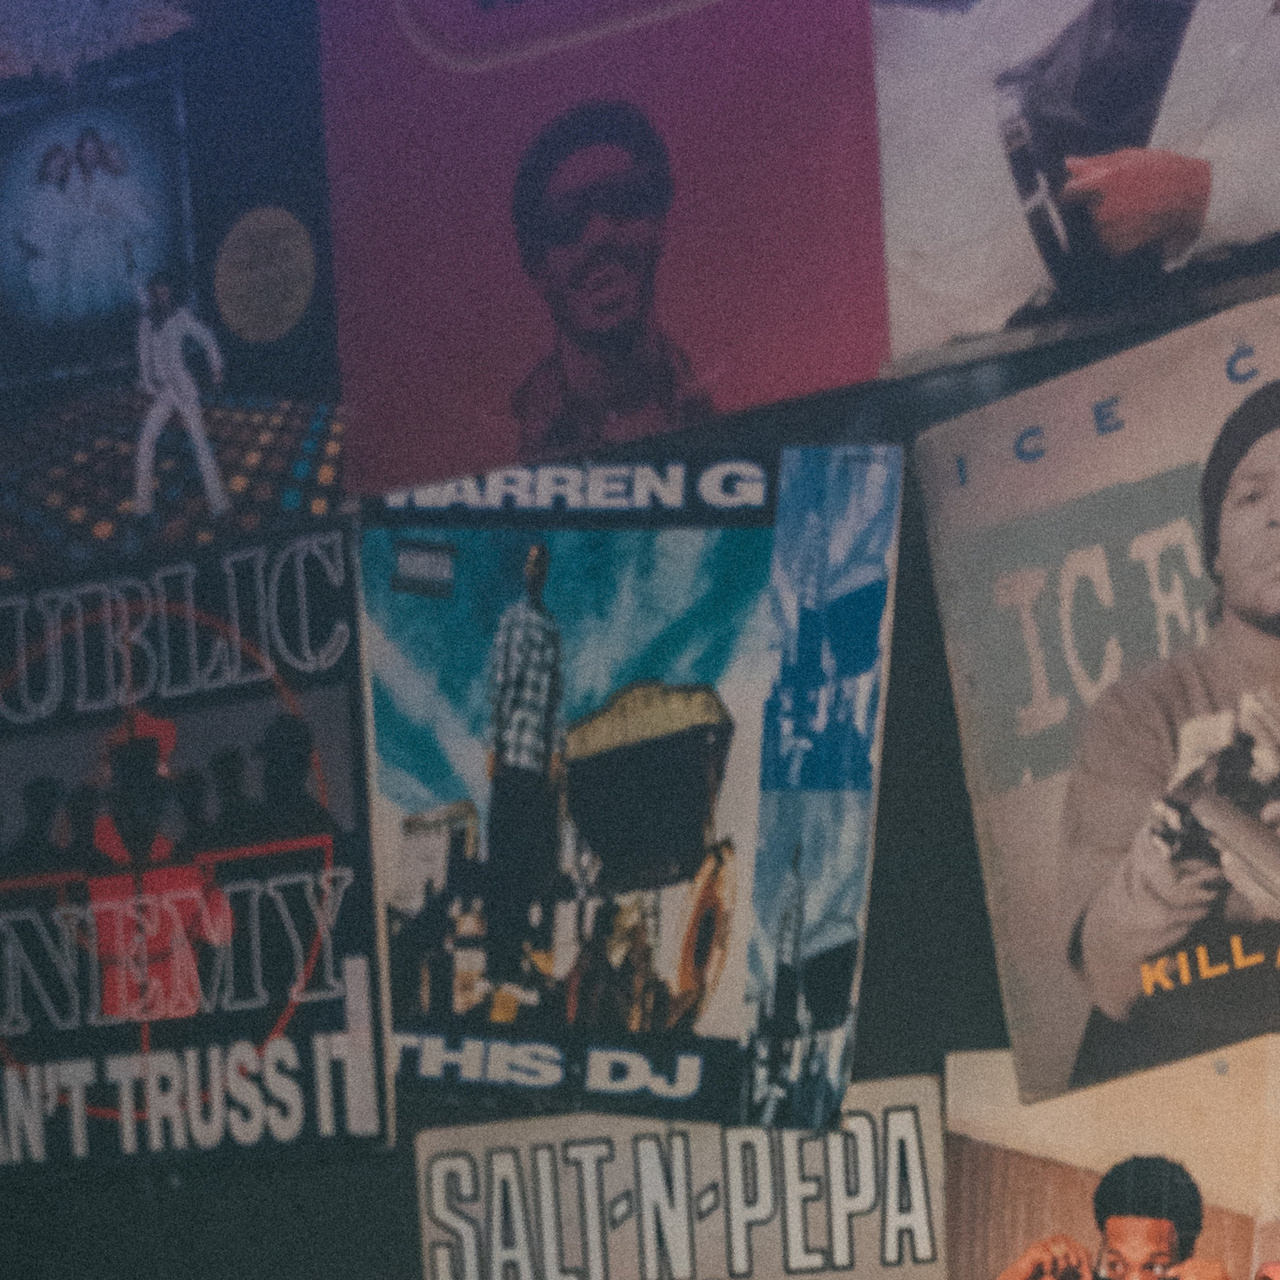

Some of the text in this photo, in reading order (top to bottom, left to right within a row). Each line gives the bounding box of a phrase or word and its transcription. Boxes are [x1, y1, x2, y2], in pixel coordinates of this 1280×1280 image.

[956, 397, 1124, 486] ICE
[699, 460, 767, 508] G
[1140, 935, 1265, 996] KILL
[106, 1037, 304, 1156] TRUSS
[586, 1047, 702, 1099] DJ
